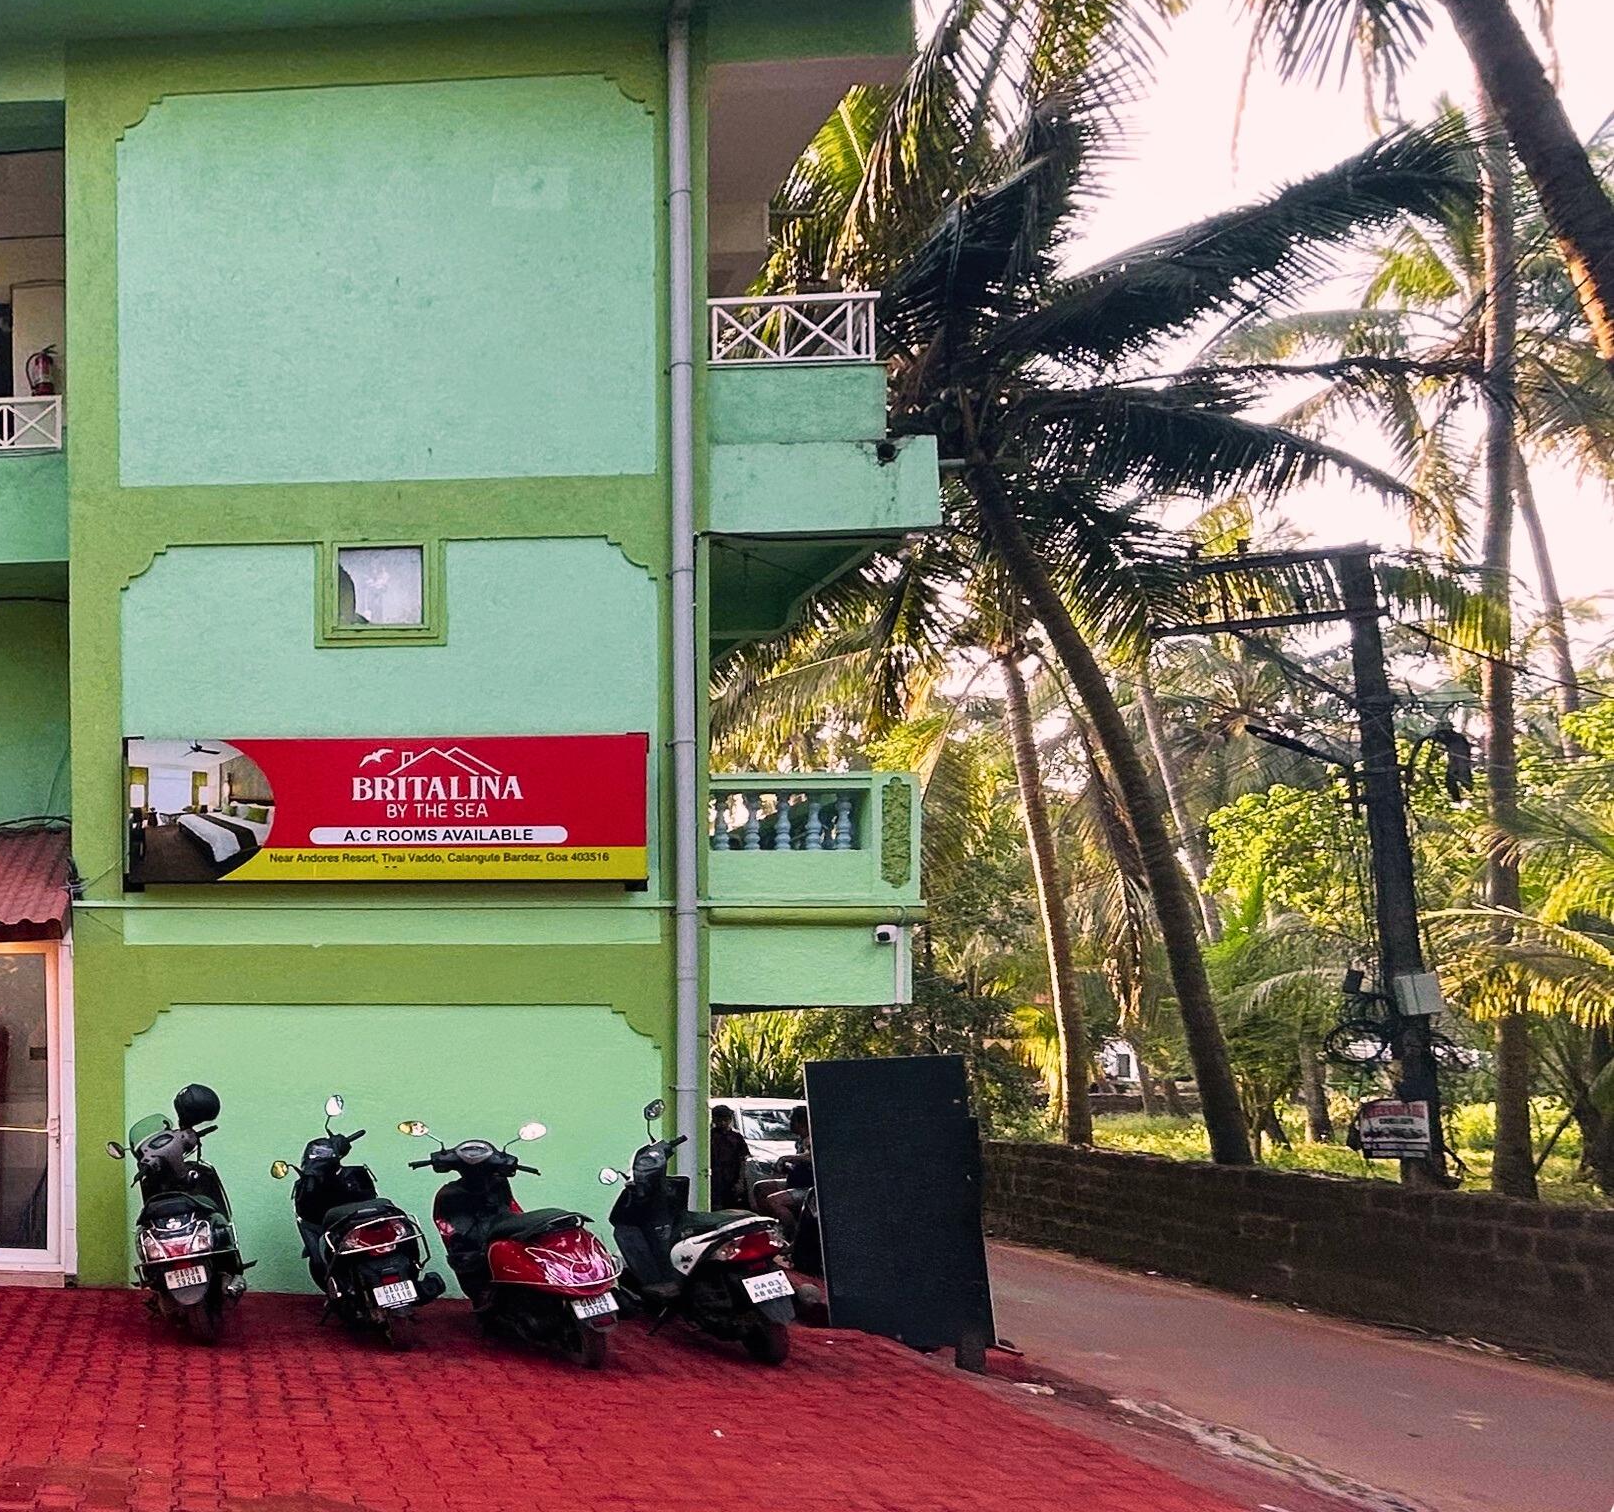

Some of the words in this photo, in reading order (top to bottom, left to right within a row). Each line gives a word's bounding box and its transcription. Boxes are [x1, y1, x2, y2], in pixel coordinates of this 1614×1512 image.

[351, 775, 524, 801] BRITALINA
[387, 803, 408, 819] BY
[414, 803, 448, 819] THE
[454, 802, 489, 818] SEA
[343, 829, 372, 842] A.C
[377, 829, 437, 842] ROOMS
[442, 828, 534, 841] AVAILABLE
[269, 853, 293, 863] Near
[296, 853, 339, 863] Andores
[342, 853, 379, 864] Resort,
[408, 852, 445, 864] Vaddo,
[447, 852, 501, 864] Calangute
[503, 852, 544, 863] Bardez,
[545, 852, 569, 862] Goa
[570, 852, 610, 862] 403516
